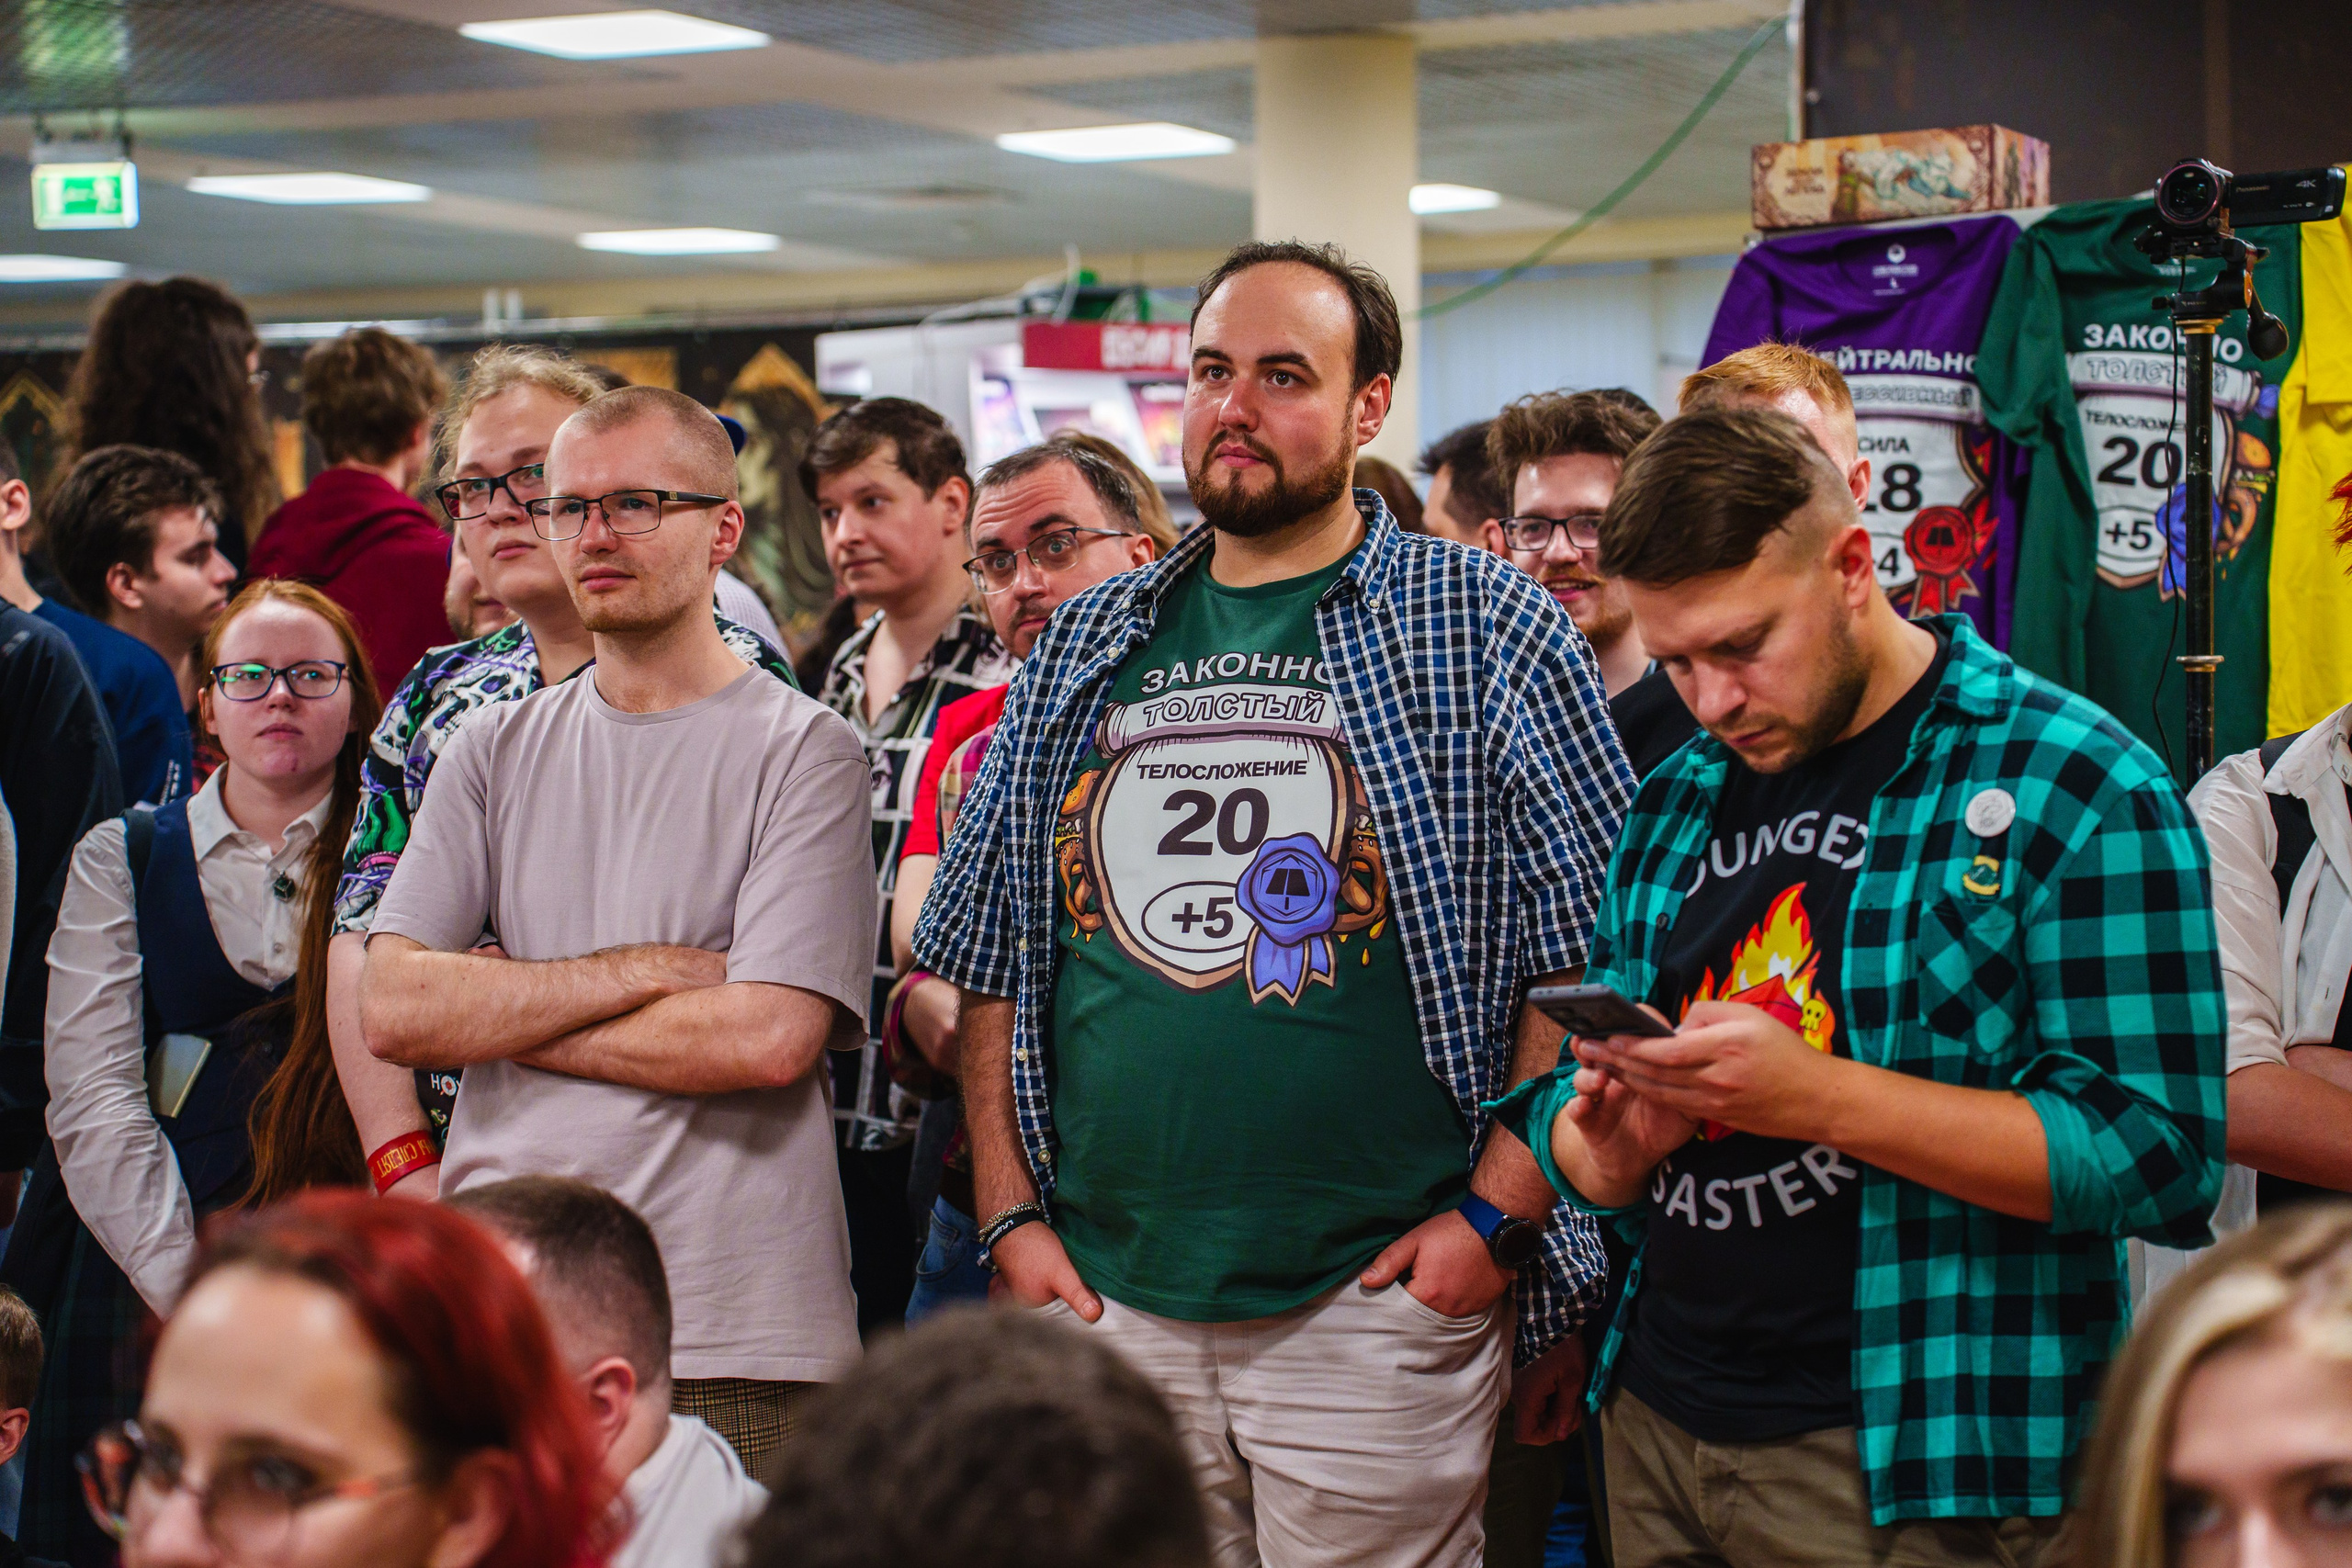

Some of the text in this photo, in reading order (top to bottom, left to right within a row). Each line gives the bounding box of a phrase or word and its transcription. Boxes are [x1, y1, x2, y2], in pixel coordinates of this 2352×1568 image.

[1819, 344, 1978, 374] ЙТРАЛЬН
[2086, 356, 2227, 394] ТОЛСТЙ
[1858, 435, 1910, 453] СИЛА
[2098, 435, 2183, 490] 20
[1865, 463, 1922, 513] 8
[2105, 519, 2154, 550] +5
[1872, 547, 1900, 577] 4
[1143, 691, 1326, 728] ТОЛСТЫЙ
[1137, 760, 1308, 782] ТЕЛОСЛОЖЕНИЕ
[1157, 788, 1271, 856] 20
[1685, 810, 1870, 900] UNGE
[1170, 897, 1235, 939] +5
[377, 1142, 418, 1178] СЛЕДЯТ
